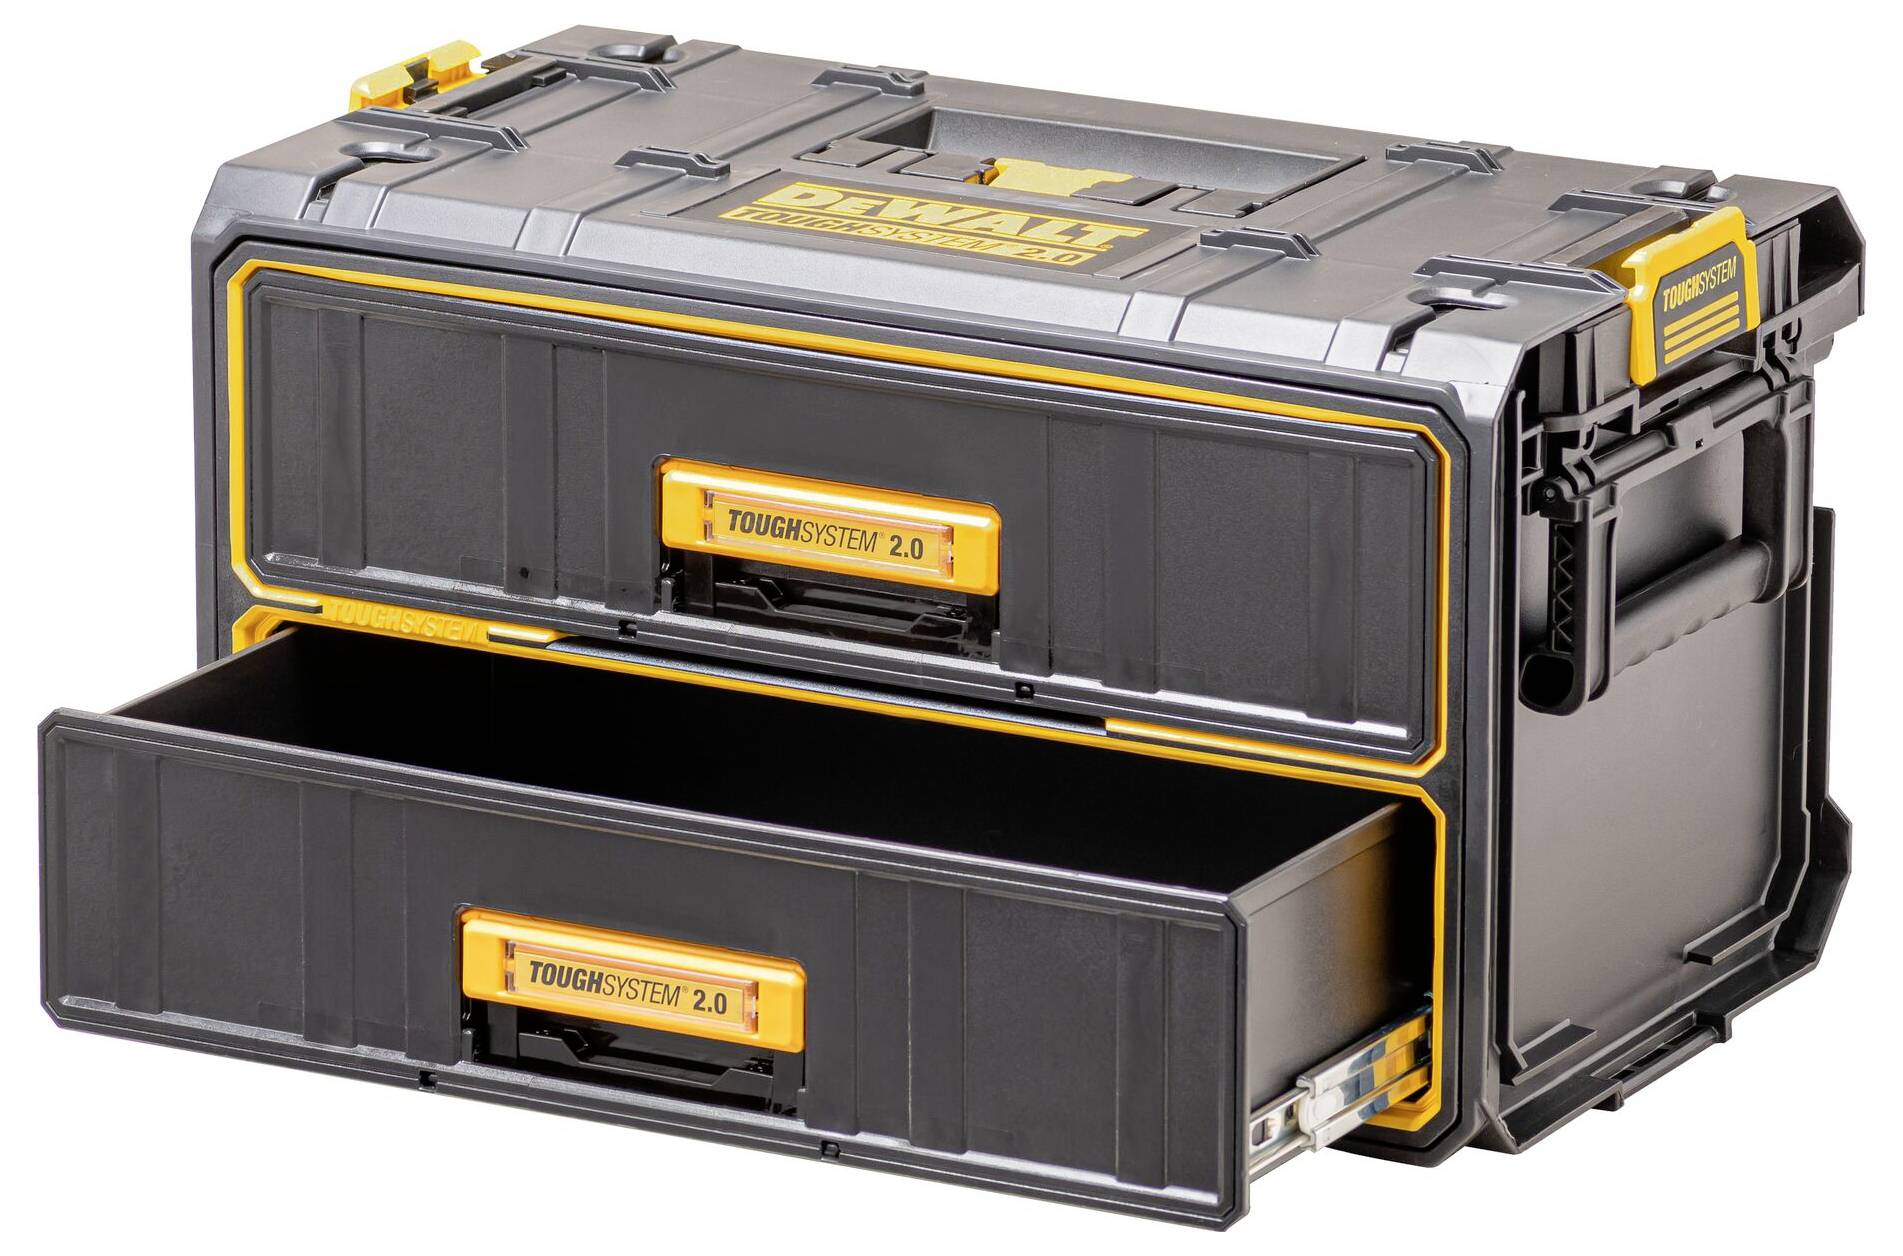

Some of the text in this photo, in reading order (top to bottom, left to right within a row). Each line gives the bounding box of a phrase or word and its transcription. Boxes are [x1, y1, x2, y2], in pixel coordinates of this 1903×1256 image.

[755, 184, 1149, 250] DEWALT
[1012, 247, 1082, 263] 2.0
[1663, 256, 1737, 312] TOUGHSYSTEM
[889, 534, 924, 560] 2.0
[329, 599, 480, 643] TOUGHSYSTEM
[693, 989, 727, 1015] 2.0
